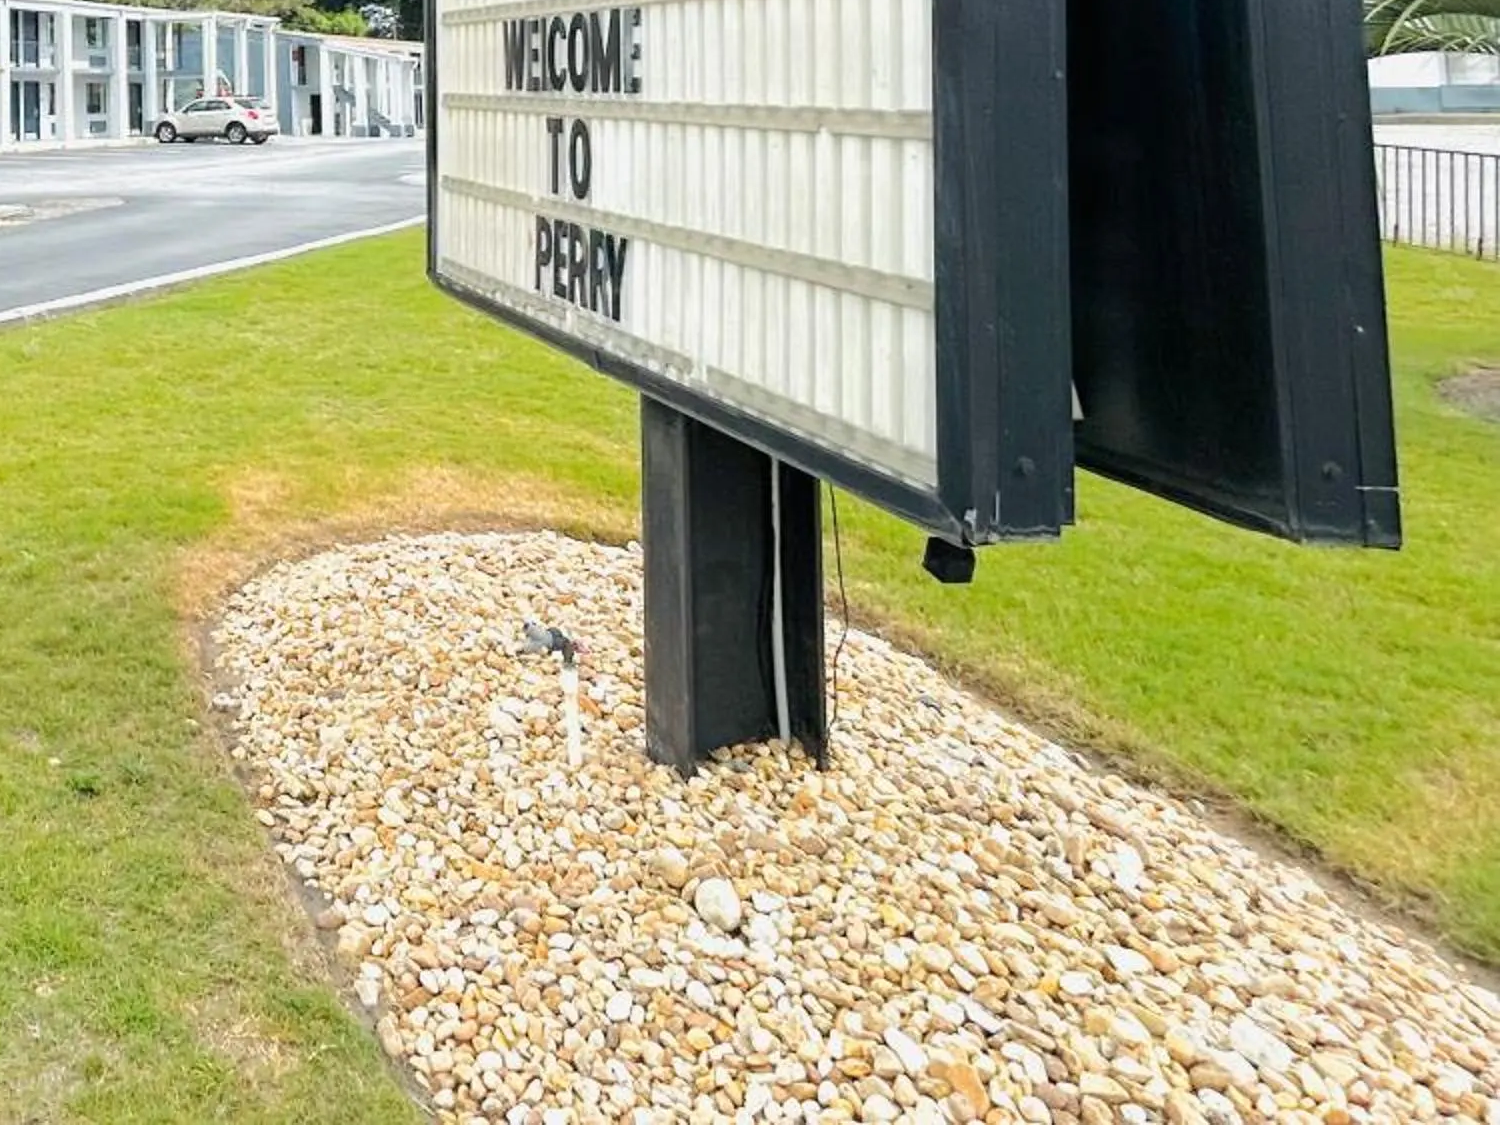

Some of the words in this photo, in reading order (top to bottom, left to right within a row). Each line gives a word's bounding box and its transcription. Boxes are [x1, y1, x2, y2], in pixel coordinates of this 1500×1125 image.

[503, 8, 642, 93] WELCOME
[546, 118, 592, 200] TO
[535, 215, 628, 322] PERRY
